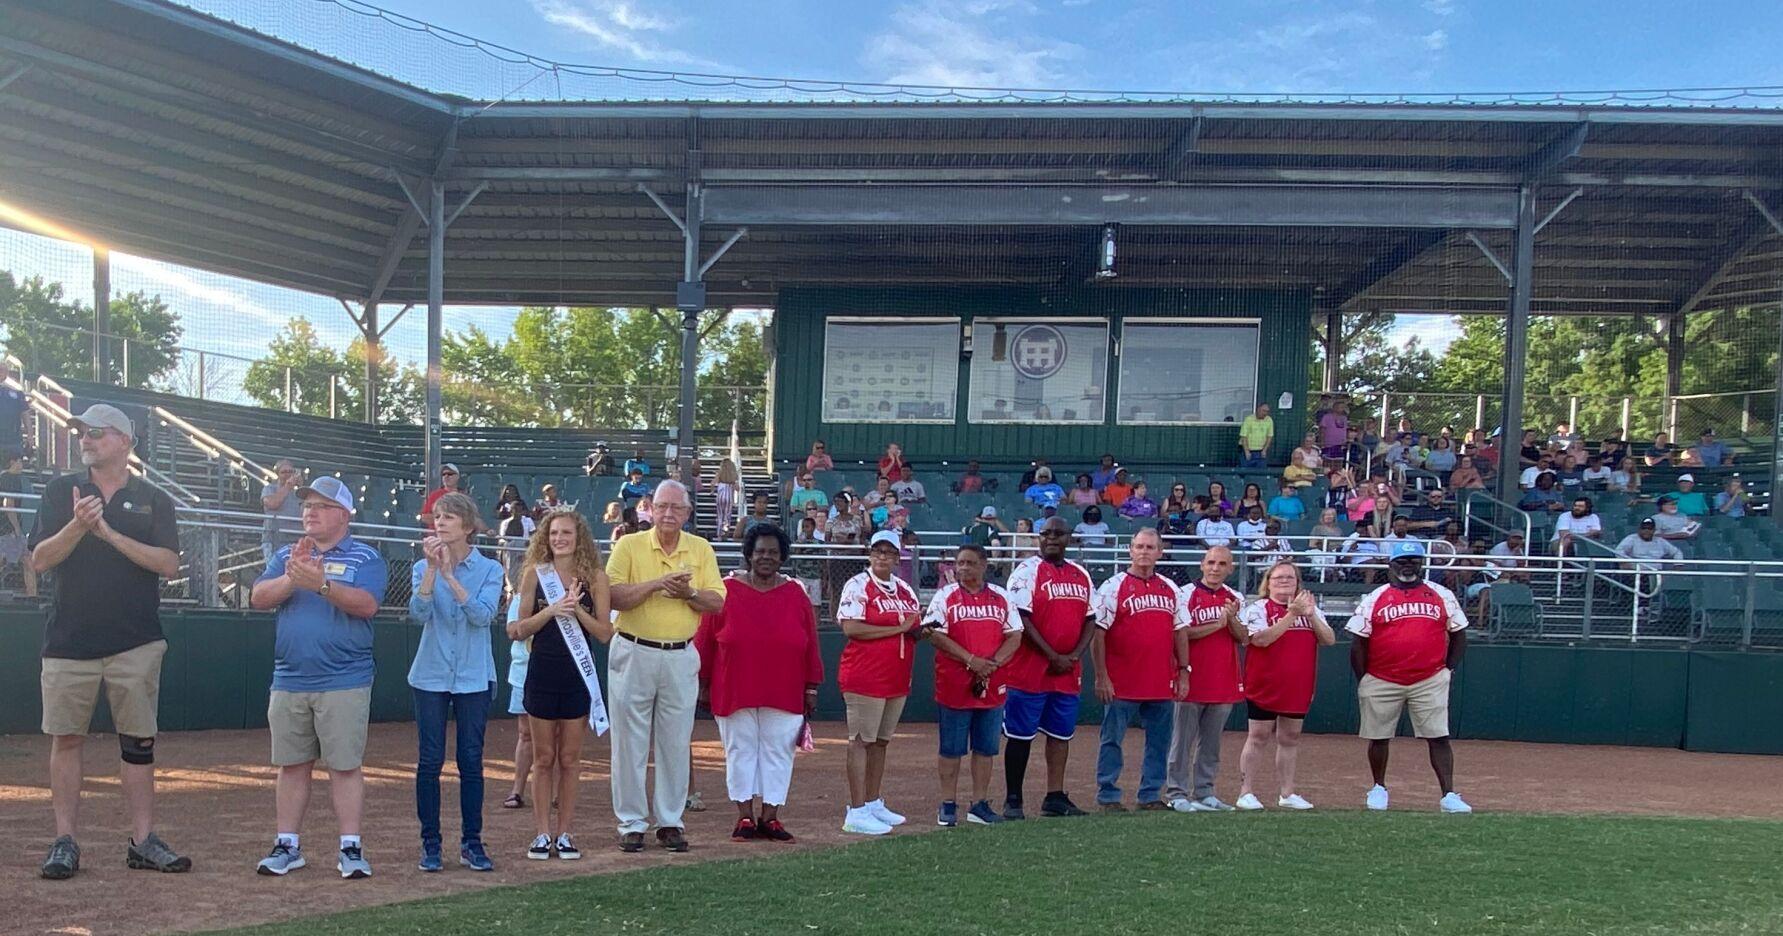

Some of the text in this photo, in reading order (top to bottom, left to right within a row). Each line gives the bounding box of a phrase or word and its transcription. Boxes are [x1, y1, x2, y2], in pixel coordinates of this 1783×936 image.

[947, 602, 1006, 624] TOMMIES
[1121, 593, 1175, 616] TOMMIES
[1377, 602, 1441, 623] TOMMIES
[545, 582, 558, 598] Miss
[579, 655, 592, 677] TEEN
